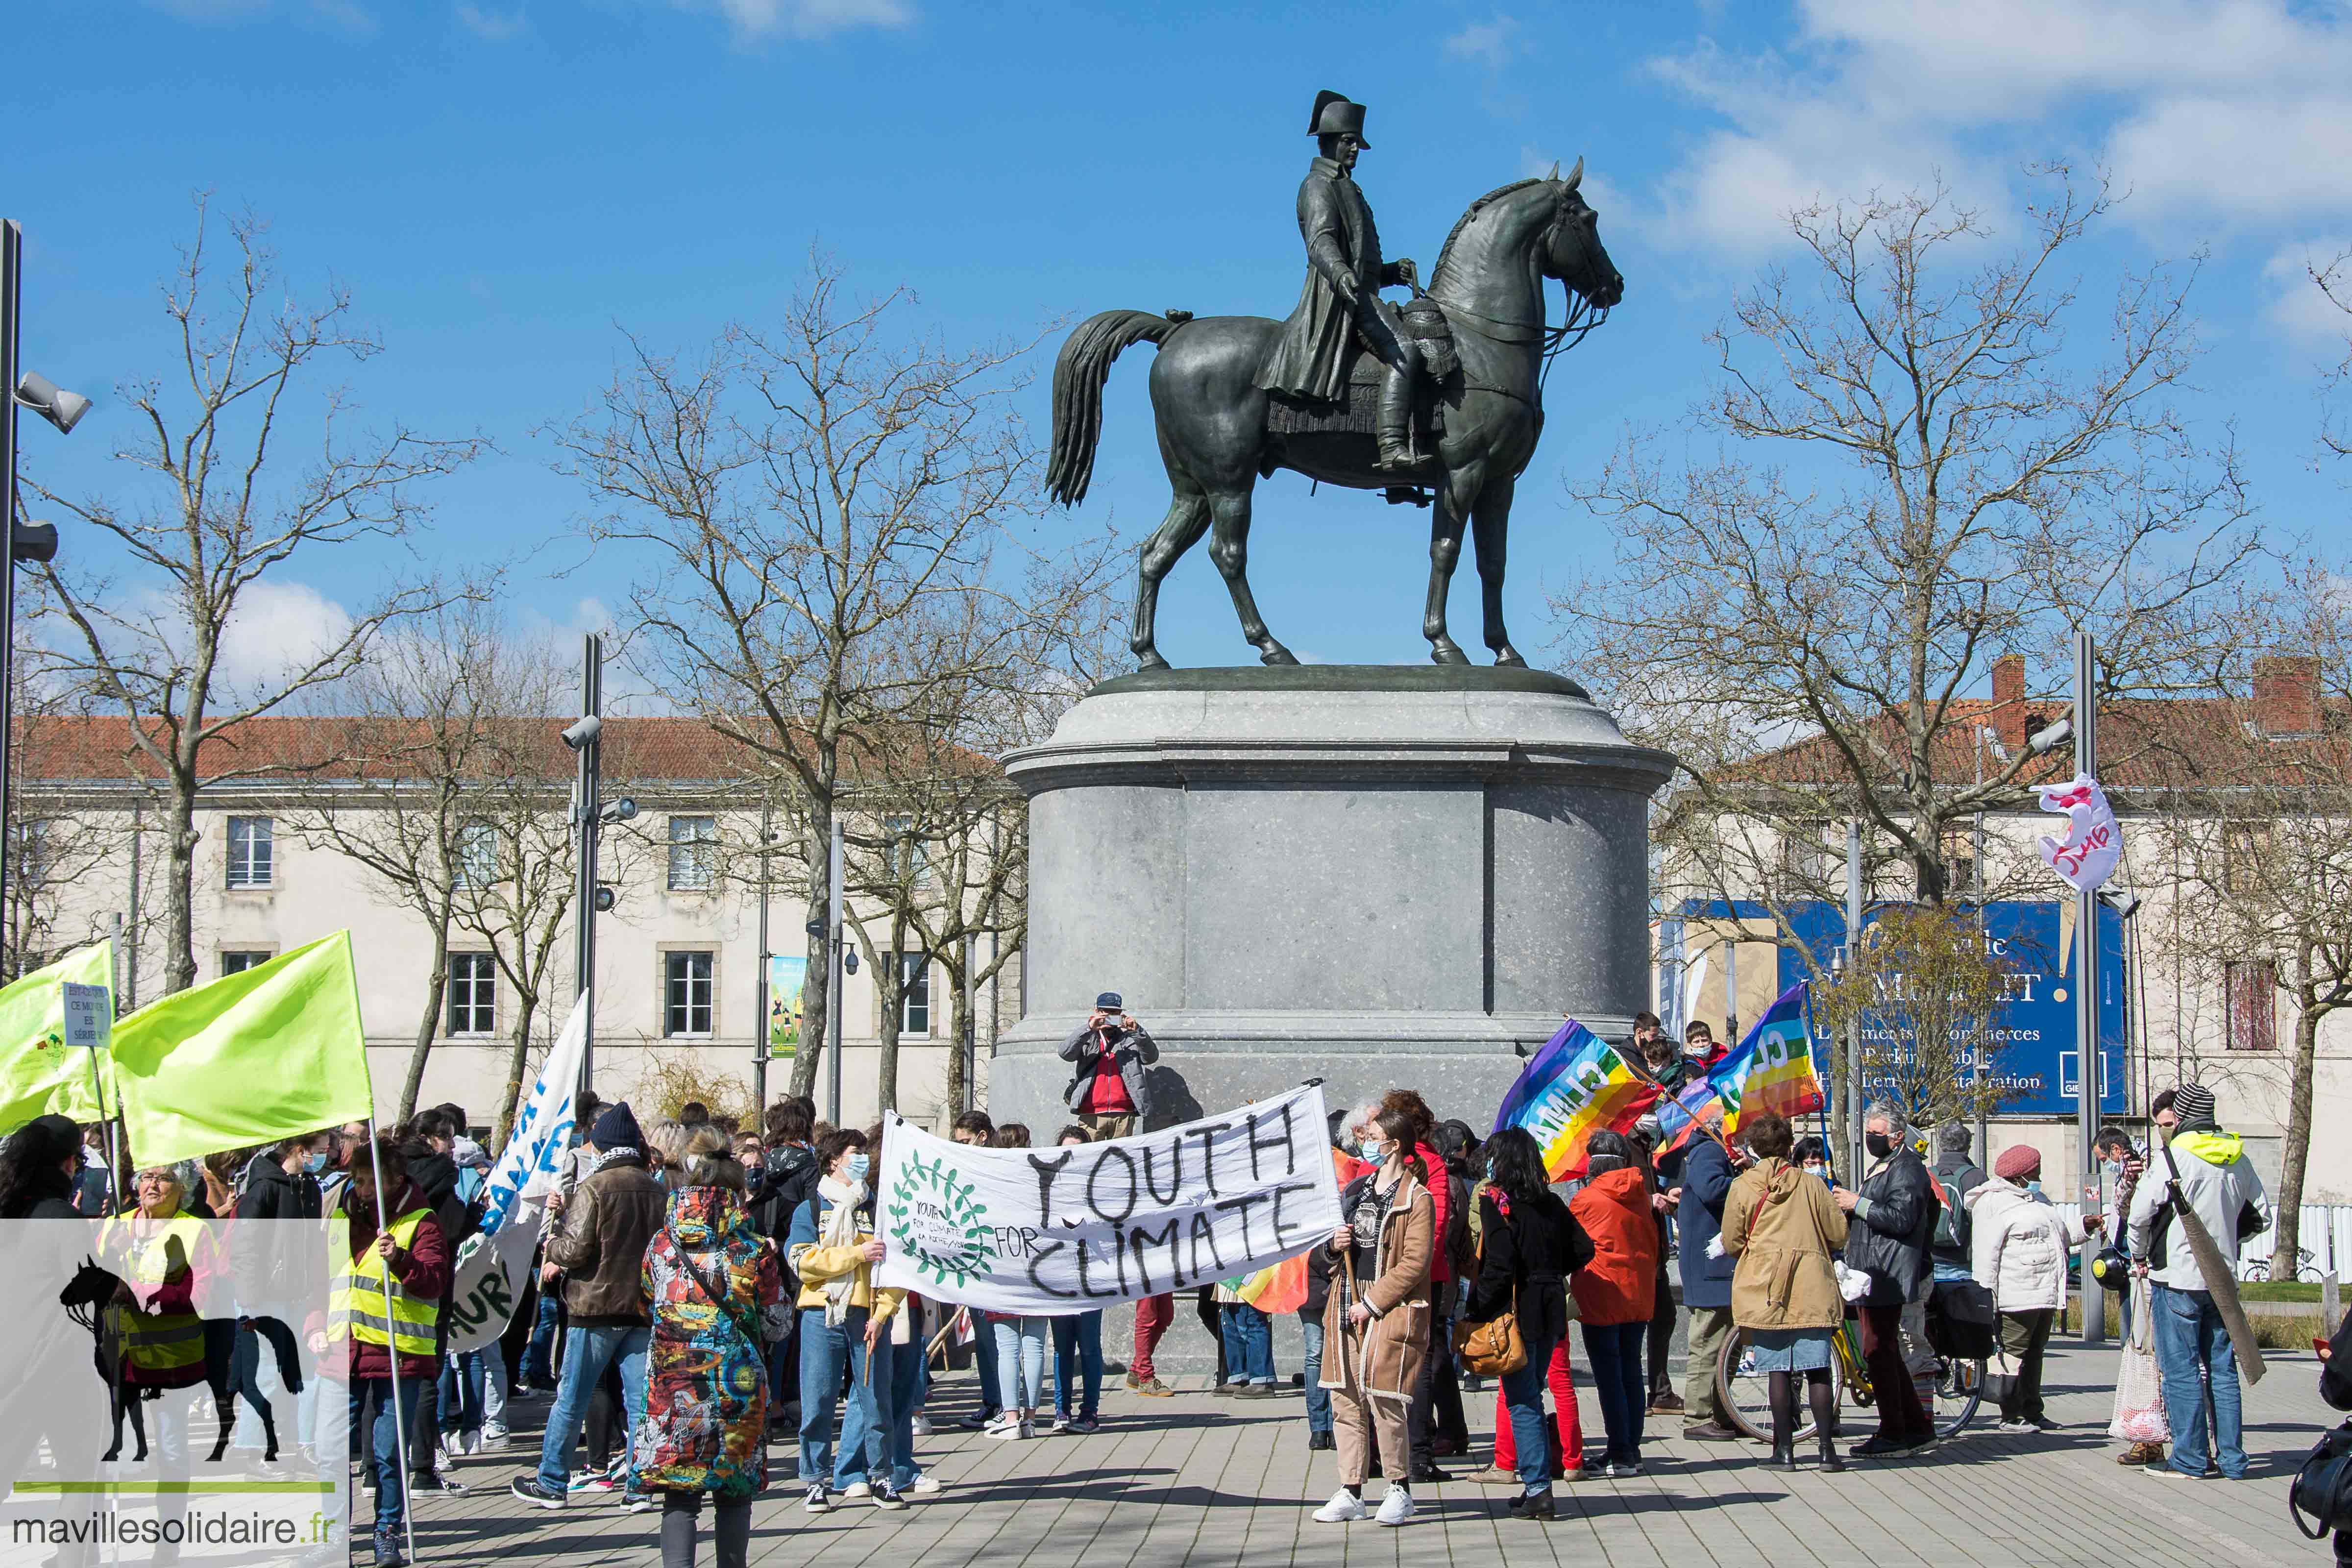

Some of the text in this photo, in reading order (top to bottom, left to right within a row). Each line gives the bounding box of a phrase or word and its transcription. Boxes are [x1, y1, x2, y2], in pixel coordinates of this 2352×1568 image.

[81, 1002, 104, 1012] MODE
[1027, 1103, 1295, 1229] YOUTH
[917, 1200, 938, 1220] YOUTH
[913, 1219, 961, 1237] FOR CLIMATE
[1028, 1182, 1315, 1297] CLIMATE
[995, 1225, 1041, 1259] FOR
